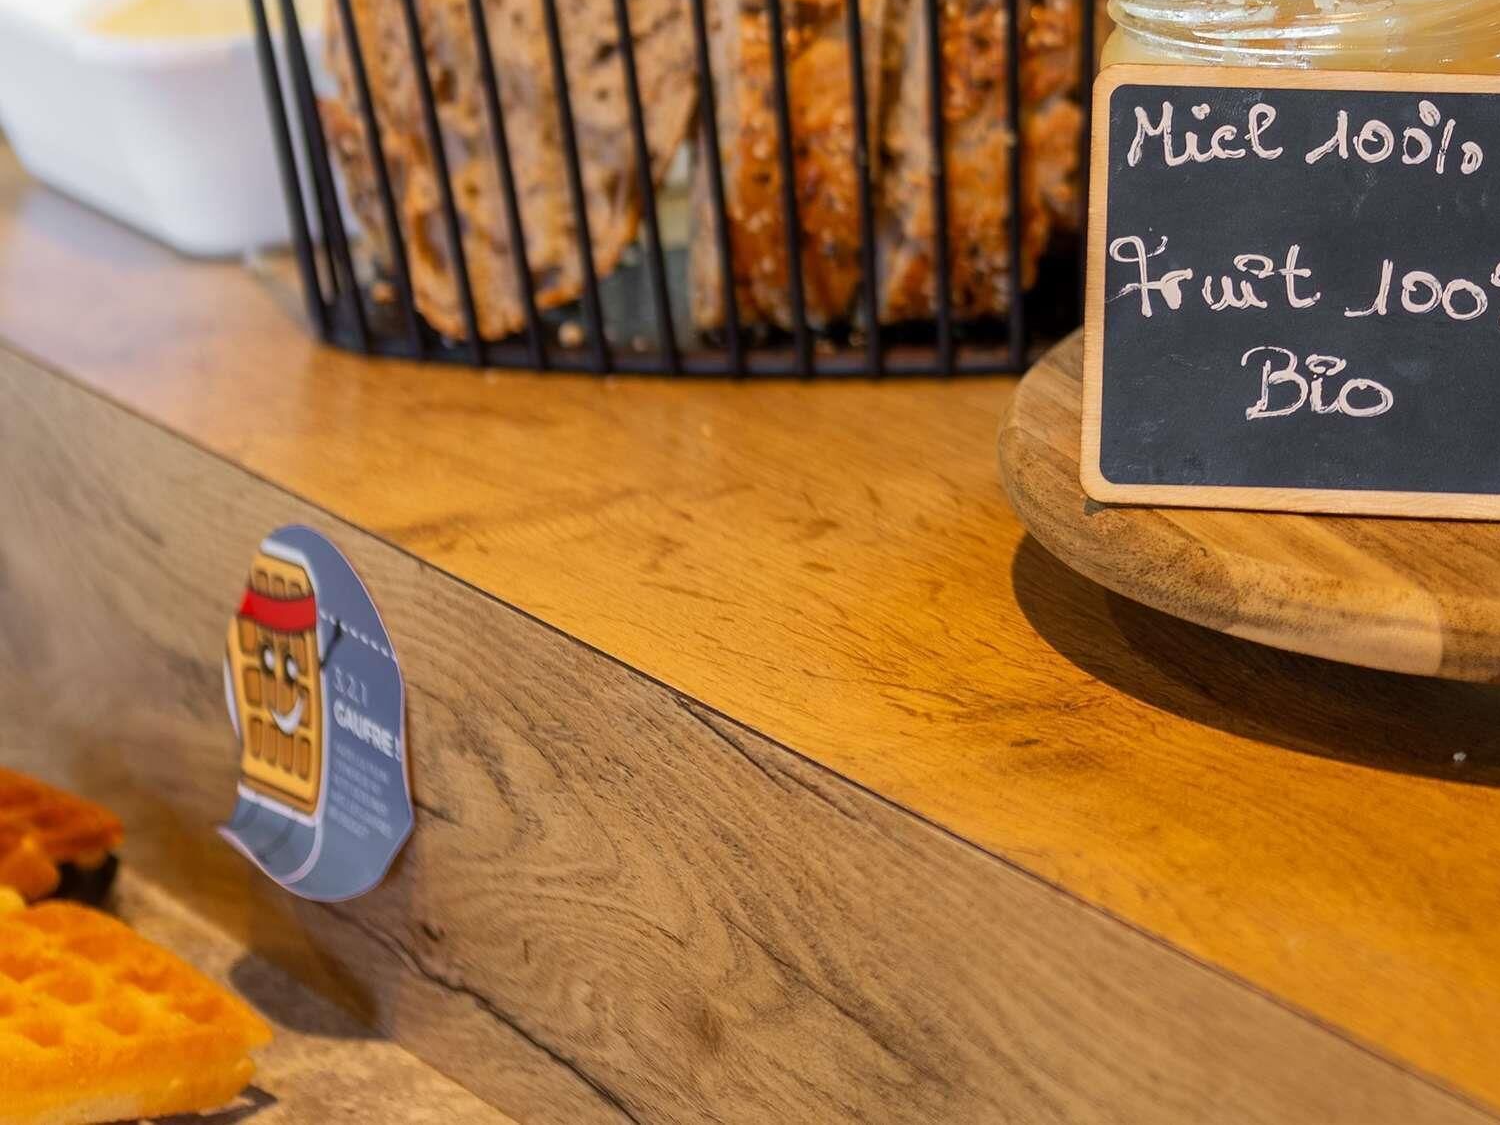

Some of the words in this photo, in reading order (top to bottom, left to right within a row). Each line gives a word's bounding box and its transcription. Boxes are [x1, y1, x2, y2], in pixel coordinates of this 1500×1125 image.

[1127, 101, 1284, 168] Miel
[1306, 100, 1484, 175] 100%
[1105, 235, 1321, 317] Fruit
[1240, 346, 1394, 421] Bio
[333, 698, 394, 758] GAUFRE
